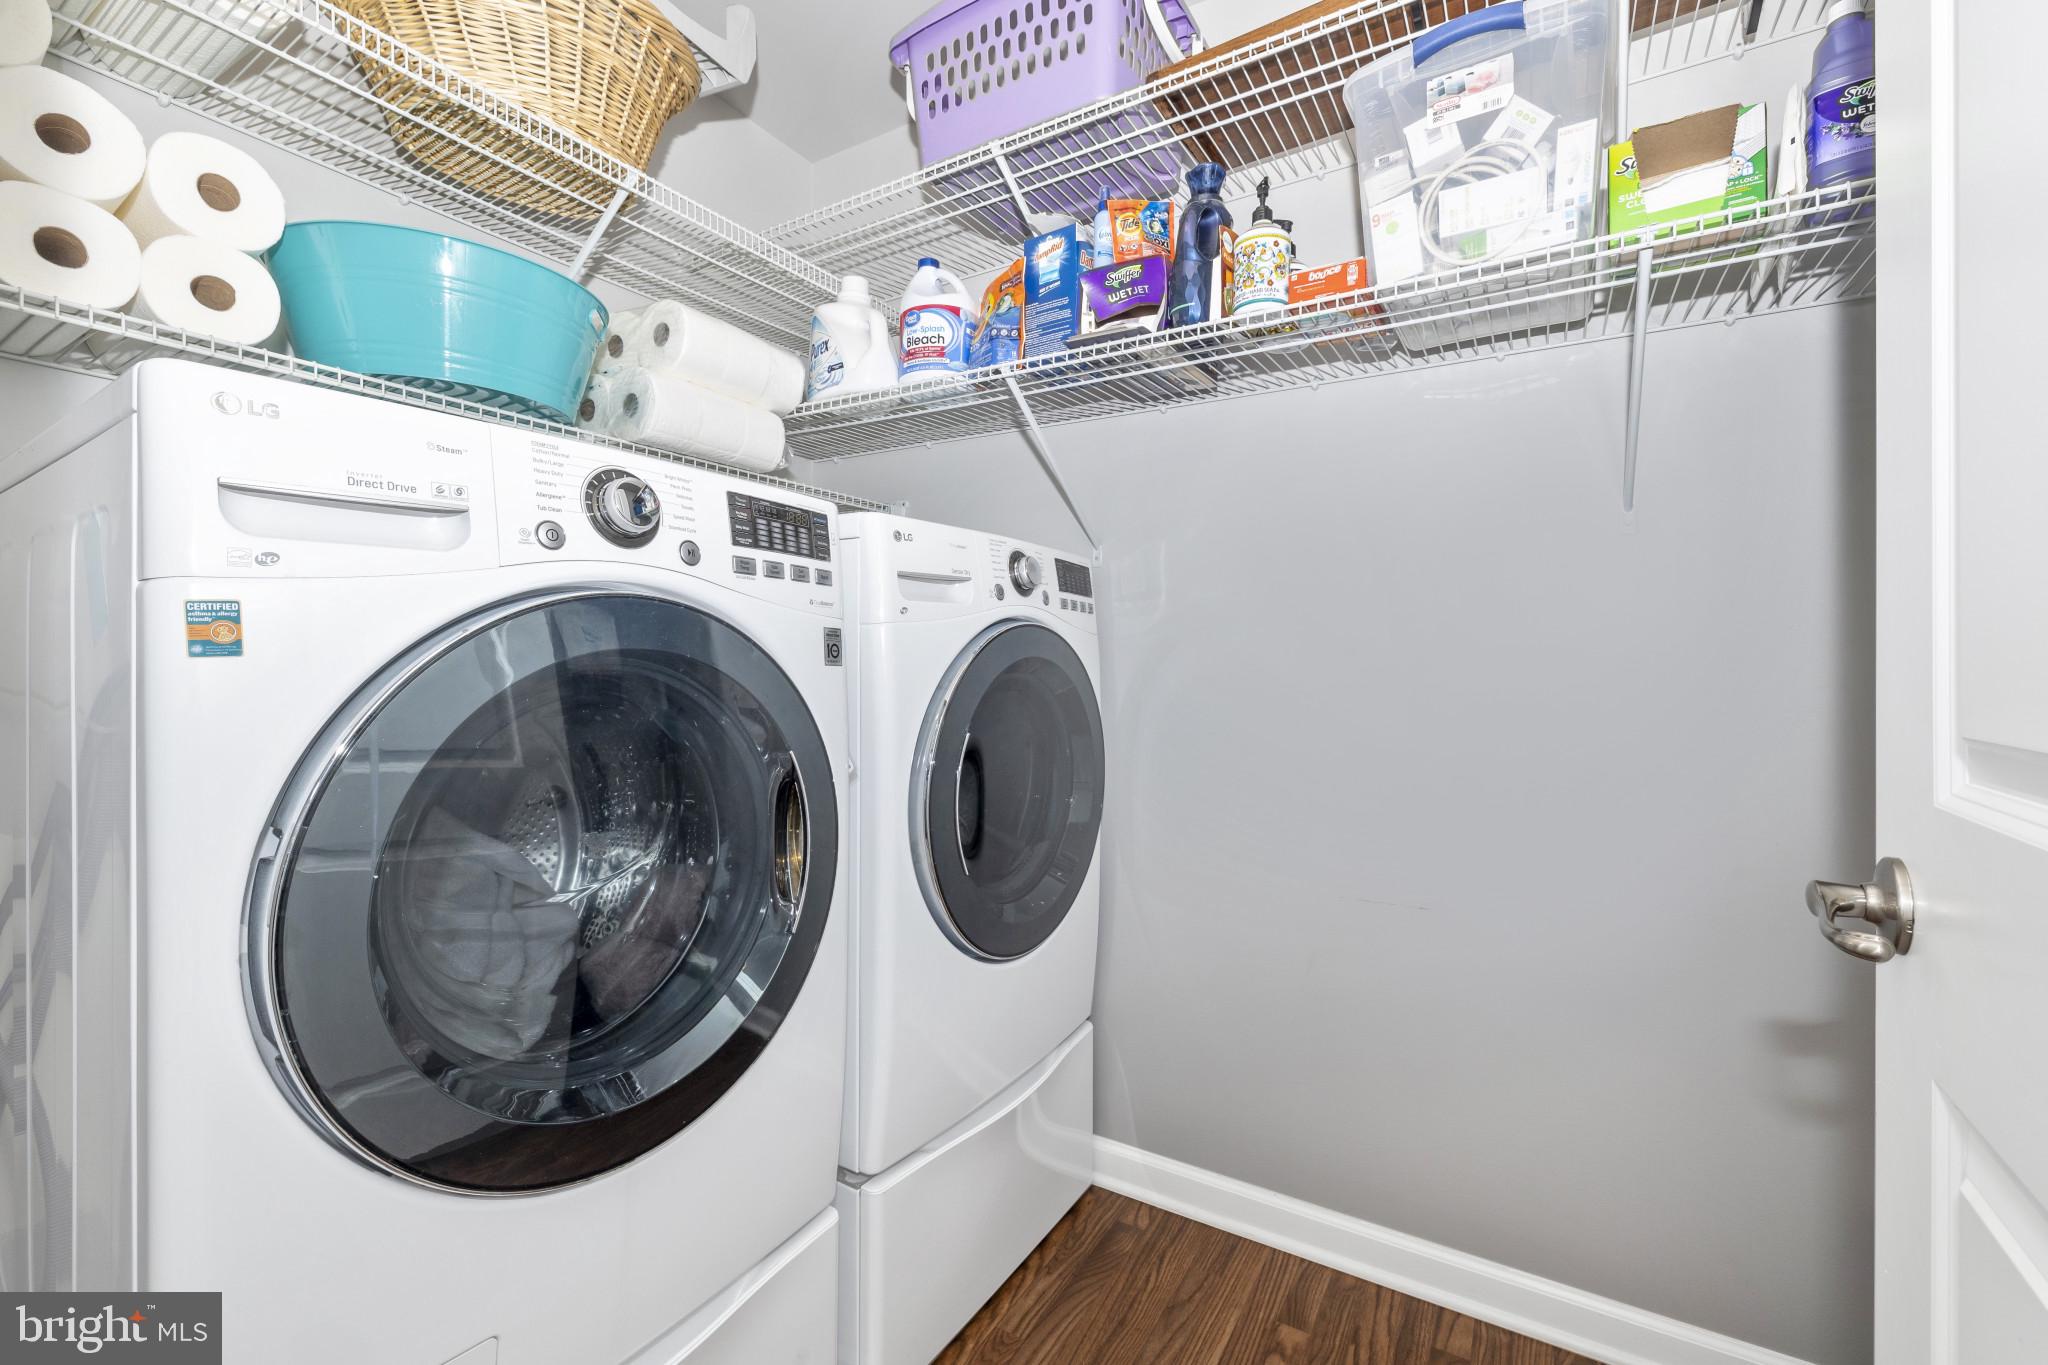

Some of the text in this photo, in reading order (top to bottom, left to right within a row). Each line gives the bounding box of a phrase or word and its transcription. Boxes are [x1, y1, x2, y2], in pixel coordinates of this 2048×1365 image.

[1840, 83, 1876, 104] Swif
[1842, 102, 1876, 118] WET
[1120, 218, 1141, 232] Tide
[1105, 269, 1142, 286] Swiffer
[1308, 264, 1343, 281] bounce
[907, 333, 945, 347] Bleach
[247, 399, 280, 420] LG
[436, 444, 463, 455] Steam
[347, 476, 417, 493] Direct Drive
[903, 533, 913, 542] LG
[186, 602, 239, 611] CERTIFIED
